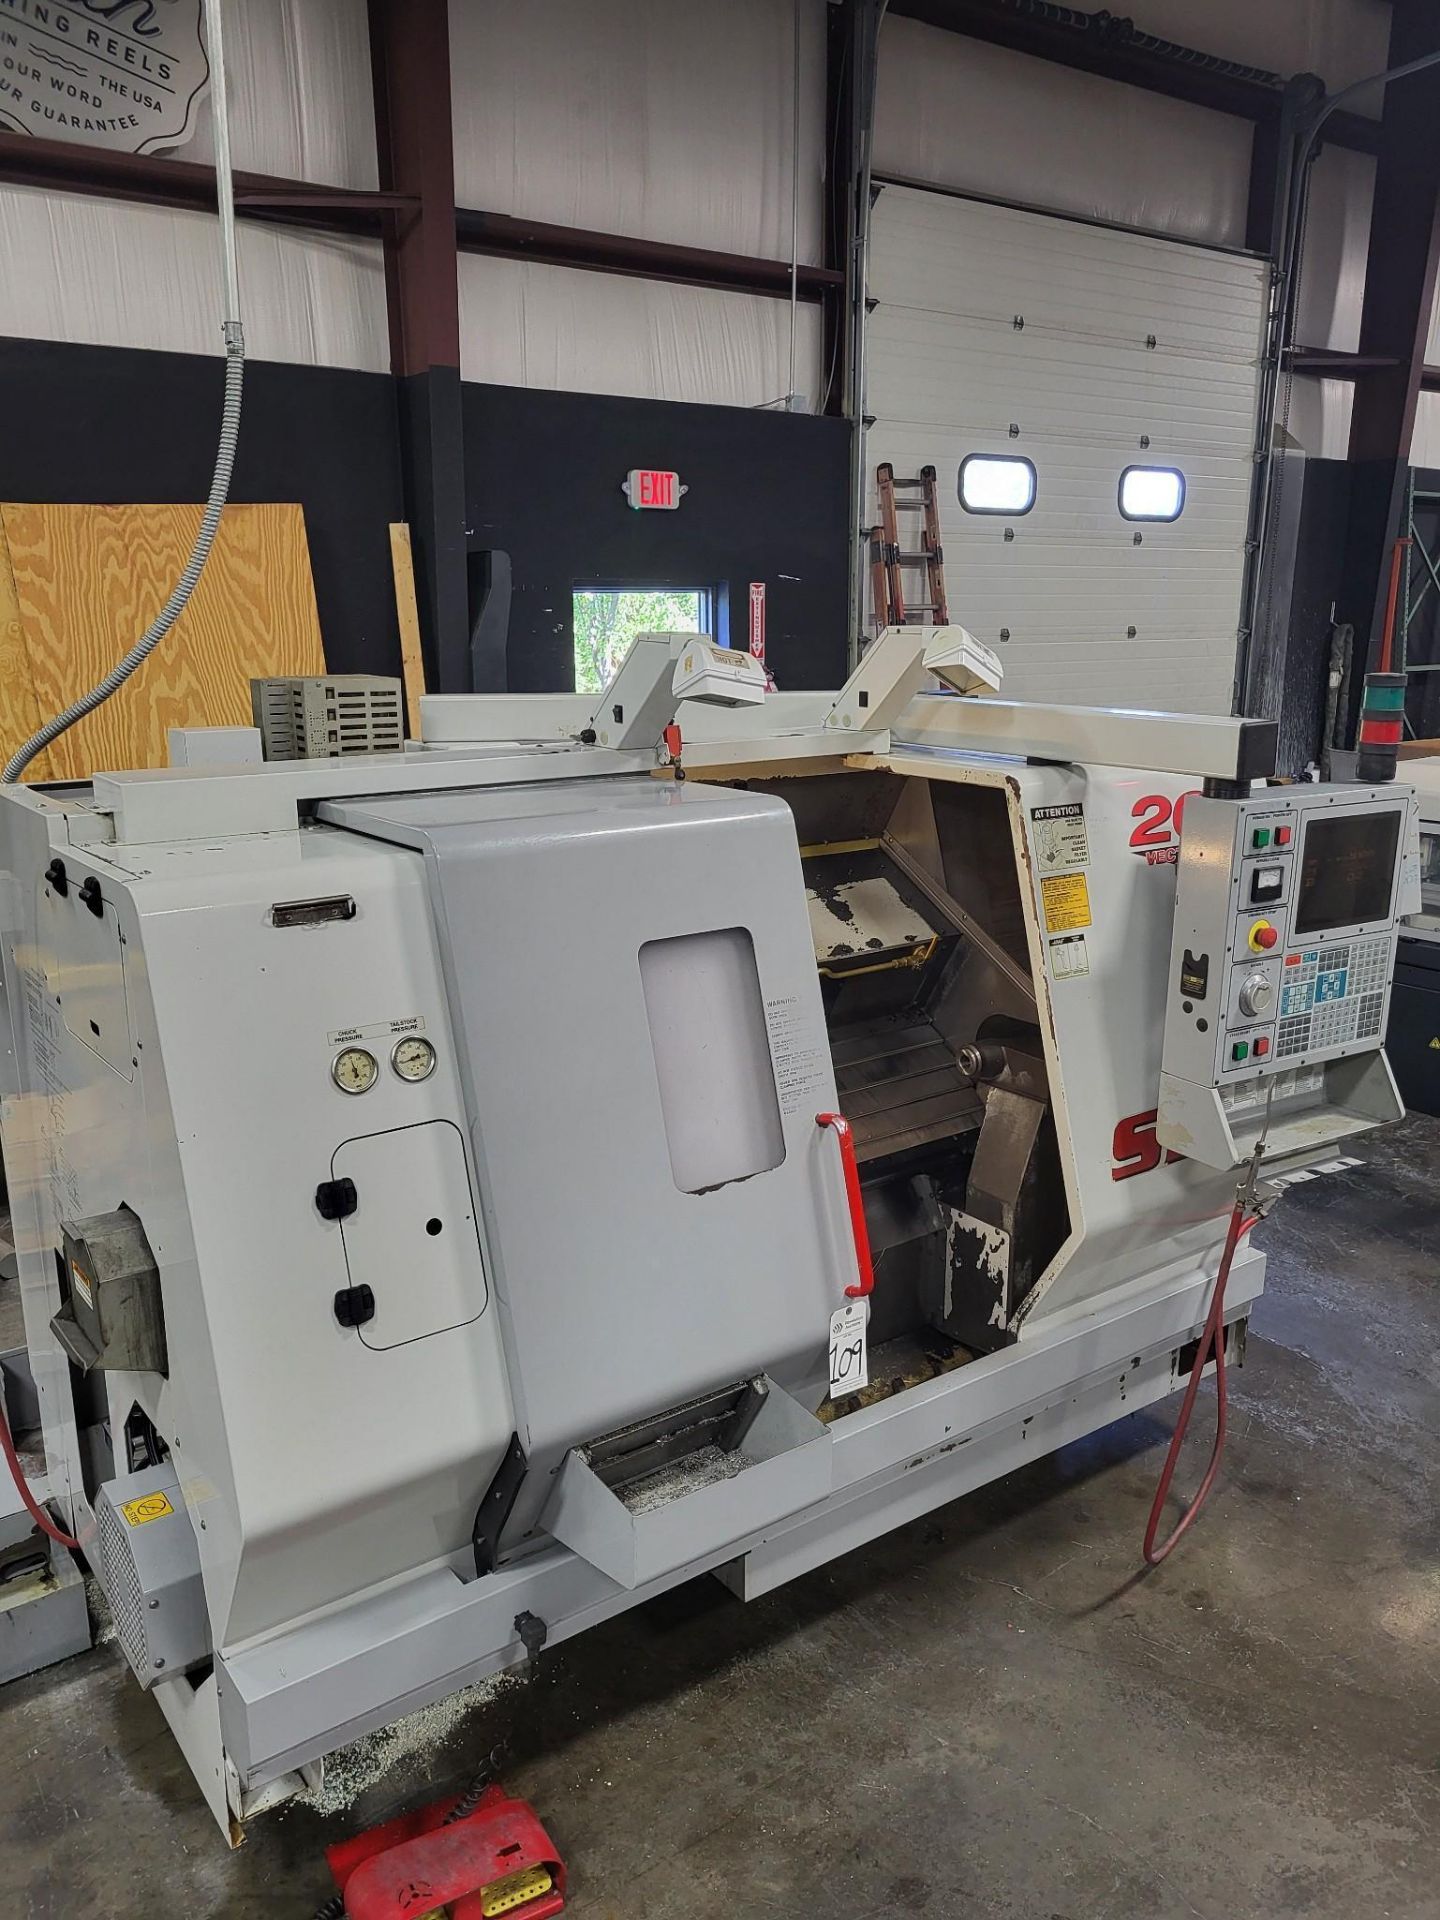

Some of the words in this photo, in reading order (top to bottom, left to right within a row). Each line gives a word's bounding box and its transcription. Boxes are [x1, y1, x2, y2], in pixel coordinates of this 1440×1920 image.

[86, 28, 172, 81] REELS
[1, 31, 18, 48] IN
[99, 74, 129, 97] THE
[133, 90, 163, 114] USA
[3, 57, 41, 82] OUR
[50, 76, 103, 109] WORD
[31, 100, 140, 132] GUARANTEE
[640, 472, 673, 505] EXIT
[1034, 805, 1080, 819] ATTENTION
[334, 1034, 363, 1043] PRESSURE
[337, 1028, 358, 1037] CHUCK
[390, 1023, 419, 1033] PRESSURE
[829, 1338, 863, 1385] 109
